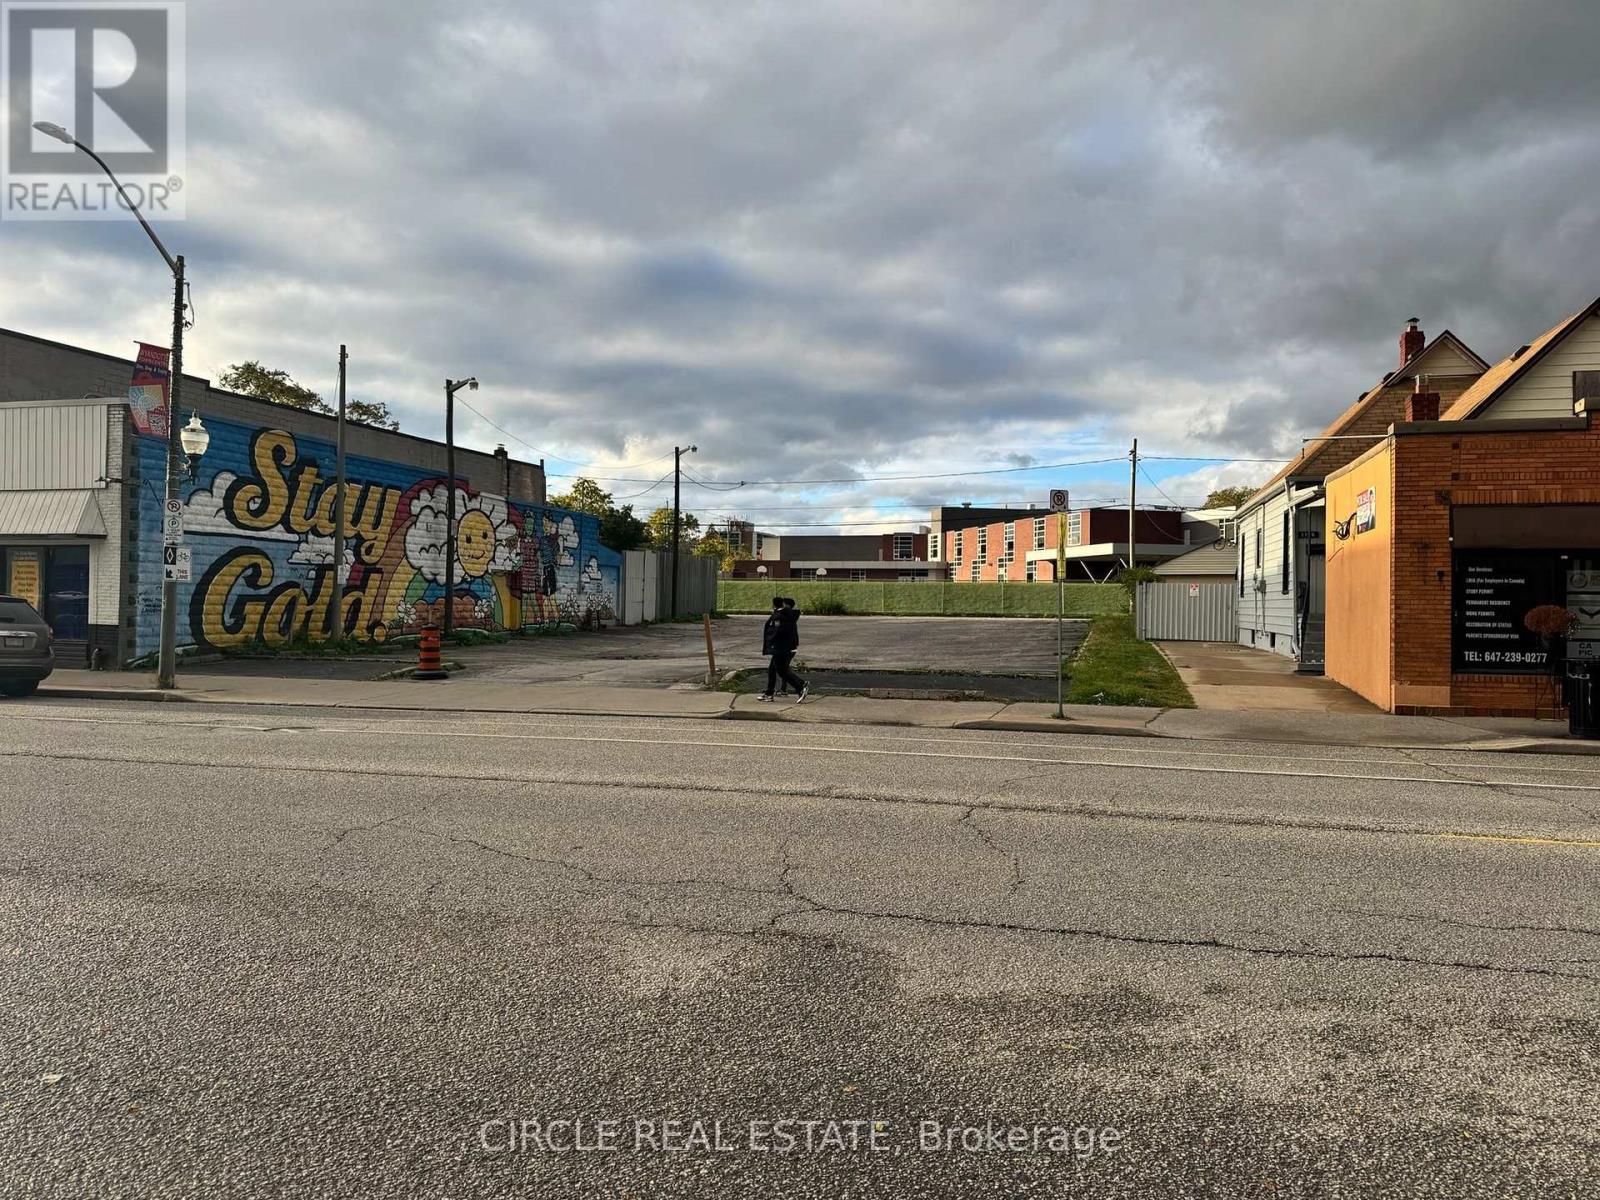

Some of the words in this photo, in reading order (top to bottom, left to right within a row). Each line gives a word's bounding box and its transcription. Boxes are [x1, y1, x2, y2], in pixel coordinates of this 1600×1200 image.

[231, 428, 402, 565] Stay
[1464, 651, 1482, 662] TEL:
[1484, 651, 1547, 664] 647-239-0277
